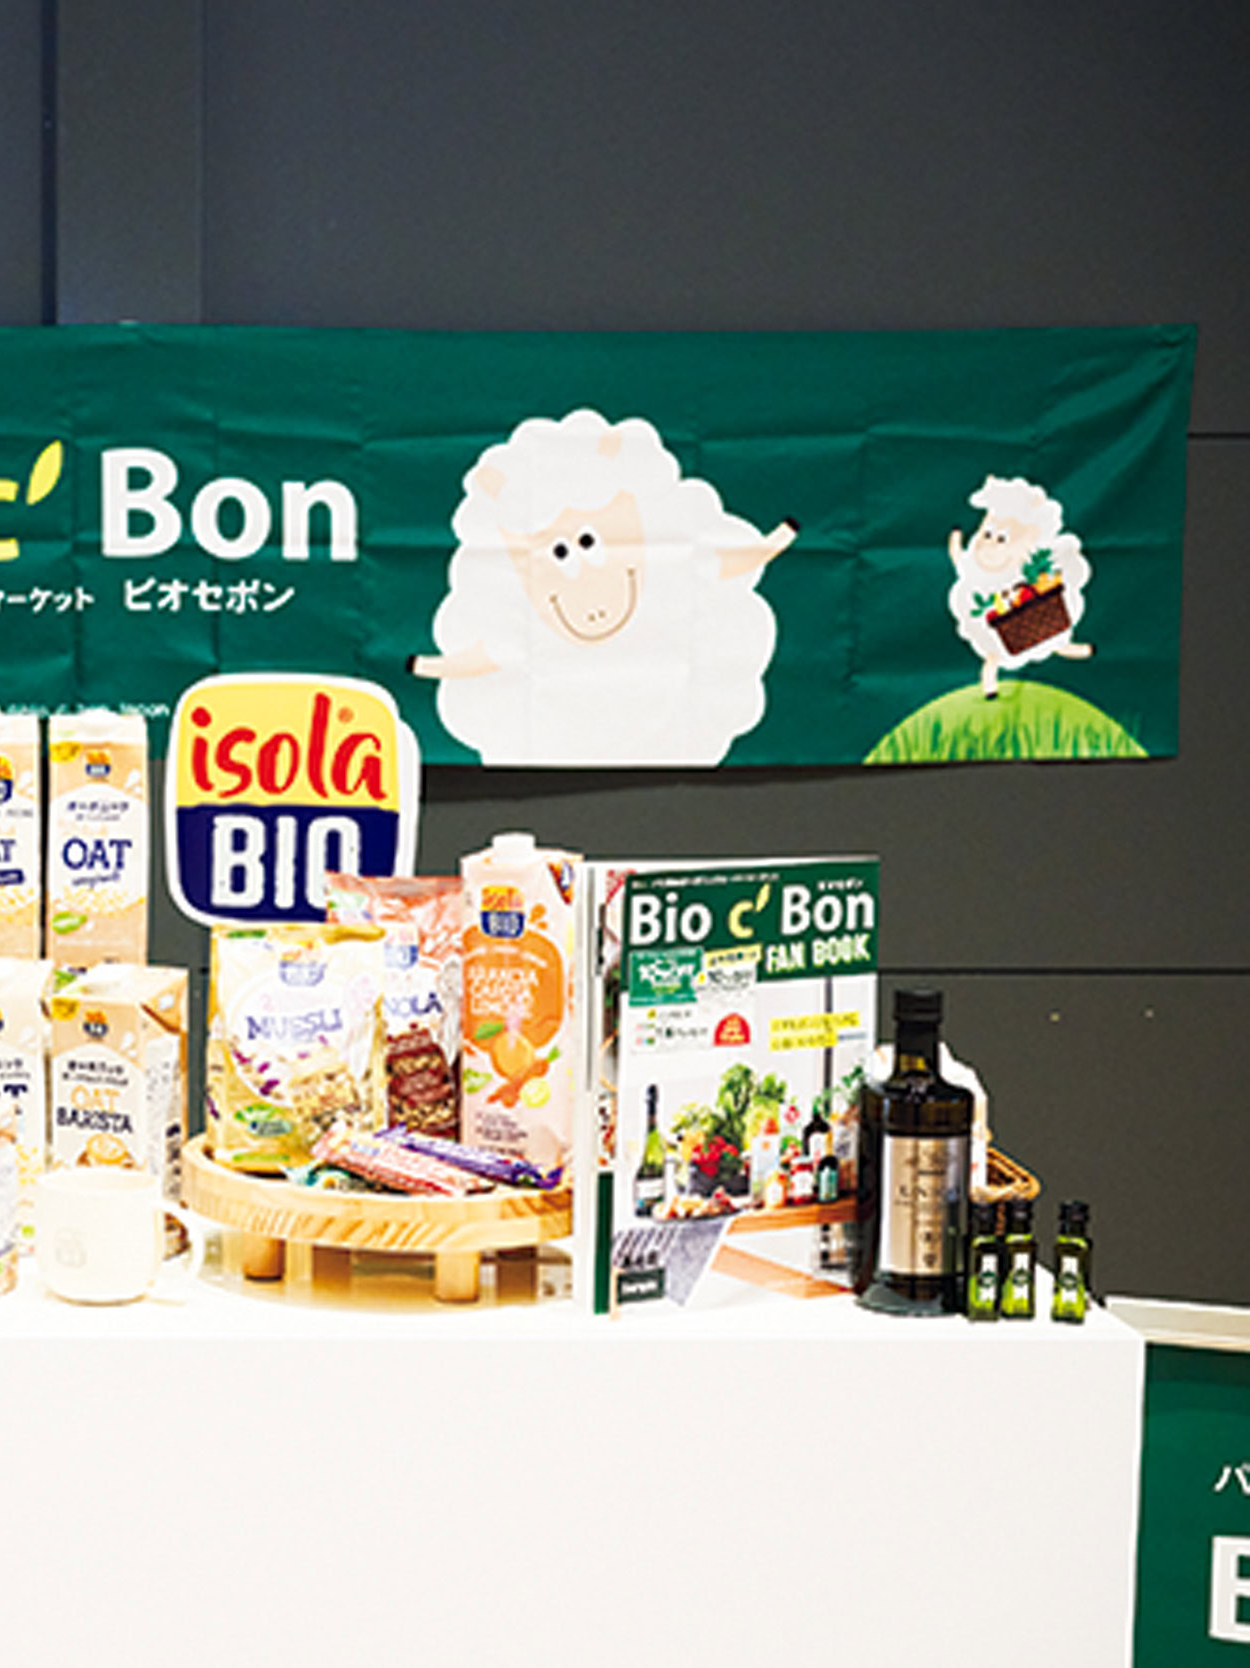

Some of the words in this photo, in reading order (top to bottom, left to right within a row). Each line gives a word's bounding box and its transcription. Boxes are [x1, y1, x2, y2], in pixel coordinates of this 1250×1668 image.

[101, 447, 358, 562] Bon
[191, 692, 387, 800] isola
[62, 838, 132, 870] OAT
[211, 814, 361, 910] BIO
[629, 892, 712, 945] Bio
[781, 885, 875, 935] Bon
[766, 943, 806, 972] FAN
[813, 934, 870, 966] BOOK
[246, 1008, 343, 1041] MUESLI
[70, 1084, 121, 1113] OAT
[56, 1106, 134, 1133] BARISTA
